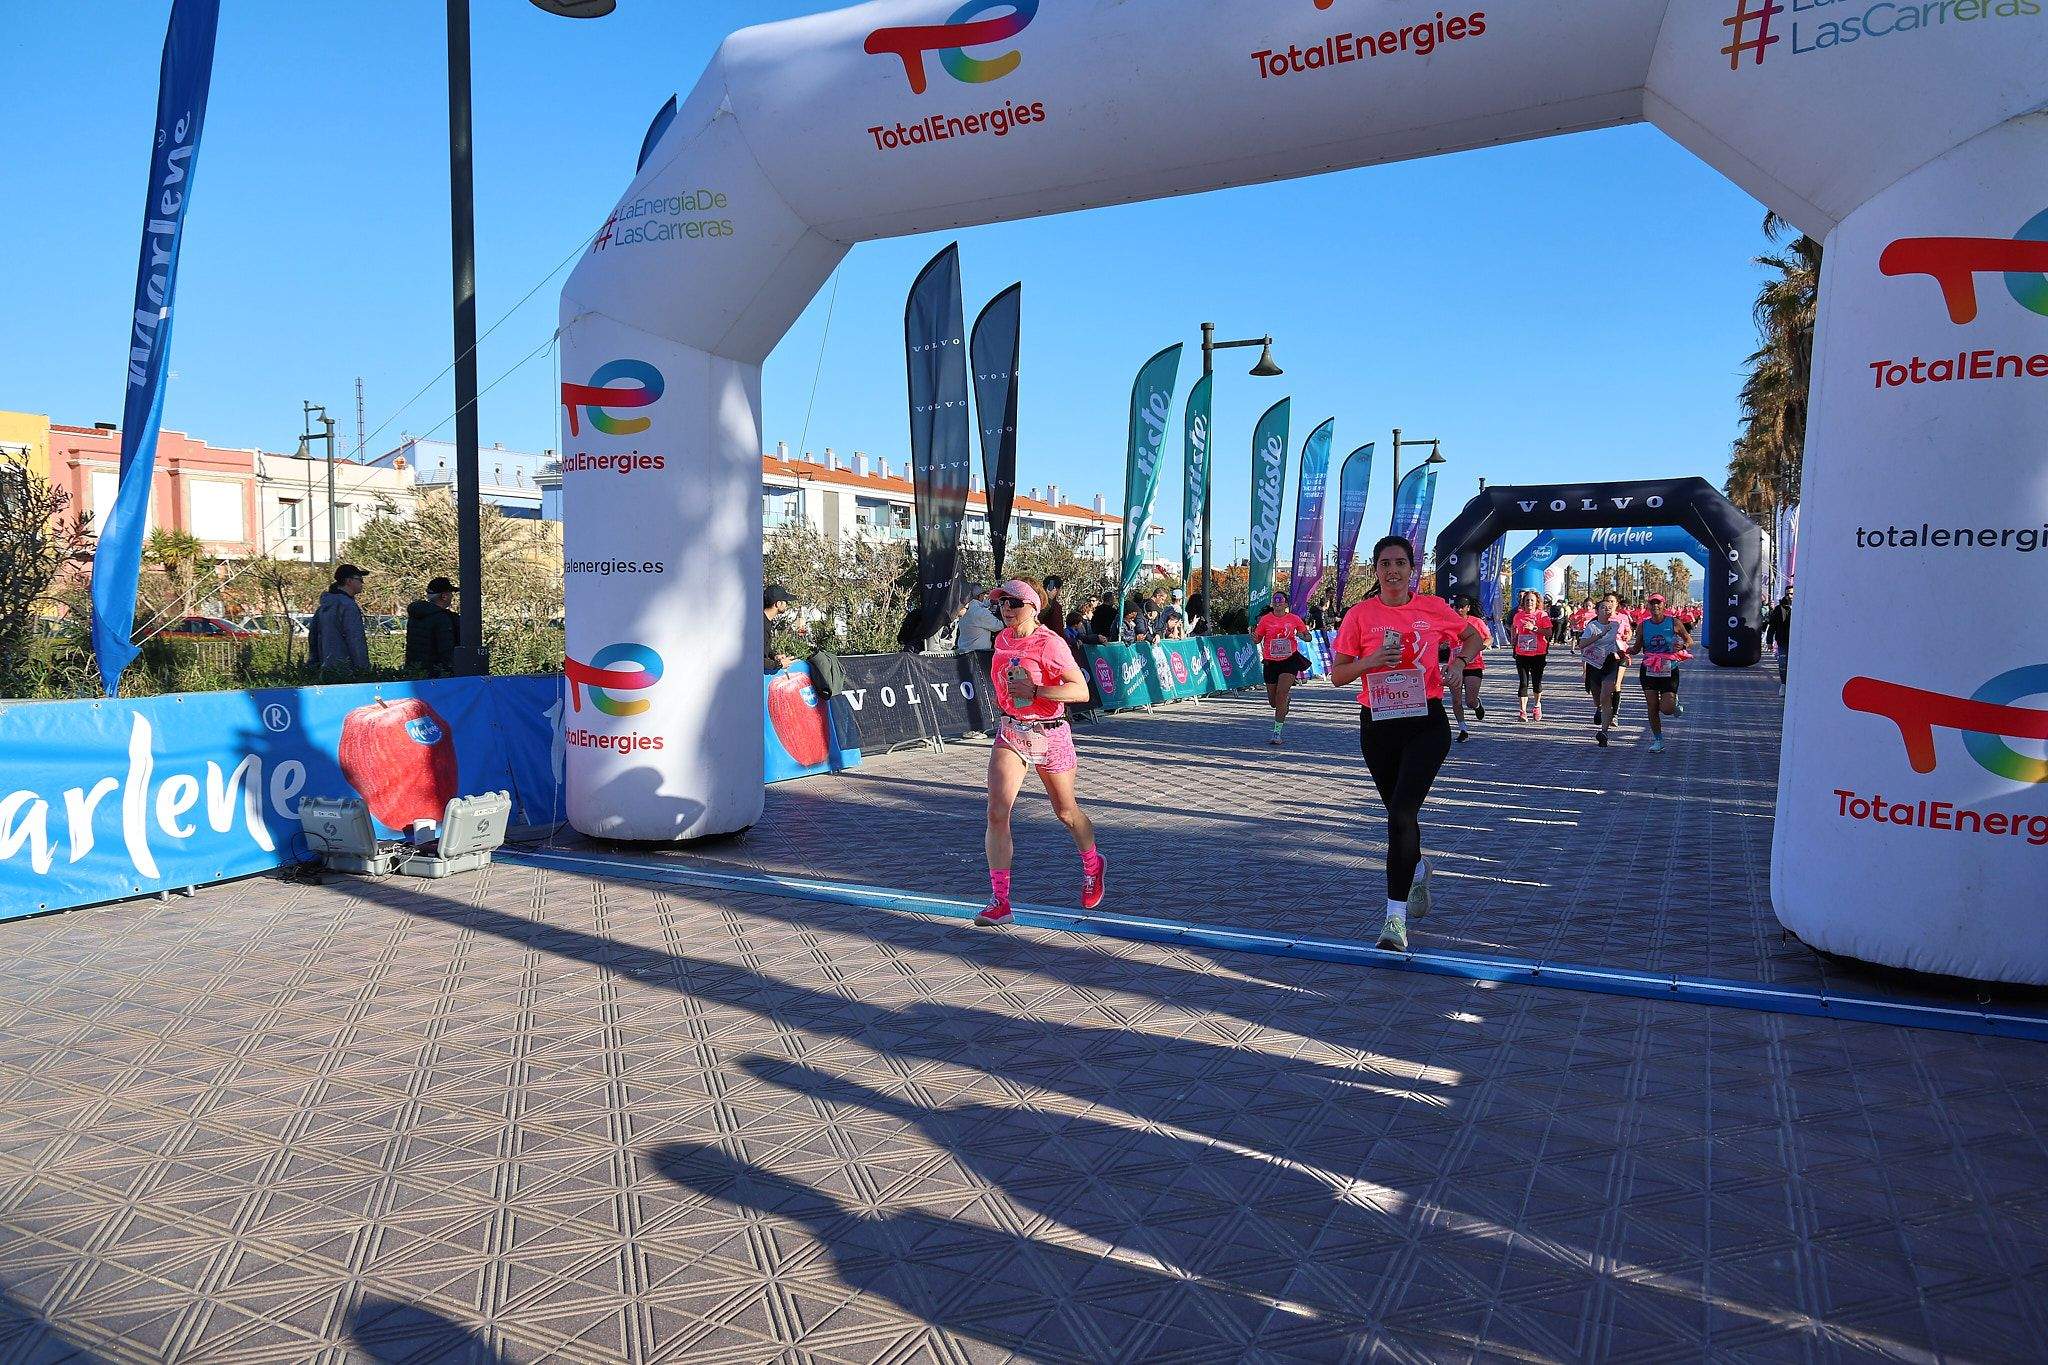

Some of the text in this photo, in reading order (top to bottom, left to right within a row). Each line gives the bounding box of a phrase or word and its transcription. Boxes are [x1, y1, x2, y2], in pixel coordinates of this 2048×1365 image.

[1792, 0, 2041, 54] LasCarreras
[1251, 12, 1487, 79] TotalEnergies
[867, 100, 1046, 151] TotalEnergies
[619, 189, 728, 221] LaEnergíaDe
[614, 219, 734, 246] LasCarreras
[912, 338, 960, 352] VOLVO
[979, 370, 1019, 380] VOLO
[1869, 350, 2048, 388] TotalEne
[915, 400, 966, 413] VOLVO
[563, 450, 665, 474] talEnergies
[919, 460, 968, 472] VOLVO
[1251, 434, 1283, 563] Batiste
[1517, 495, 1664, 513] VOLVO
[1590, 527, 1653, 550] Marlene
[1728, 549, 1739, 652] VOLVO
[841, 680, 975, 711] VOLVO
[565, 727, 664, 754] talEnergies
